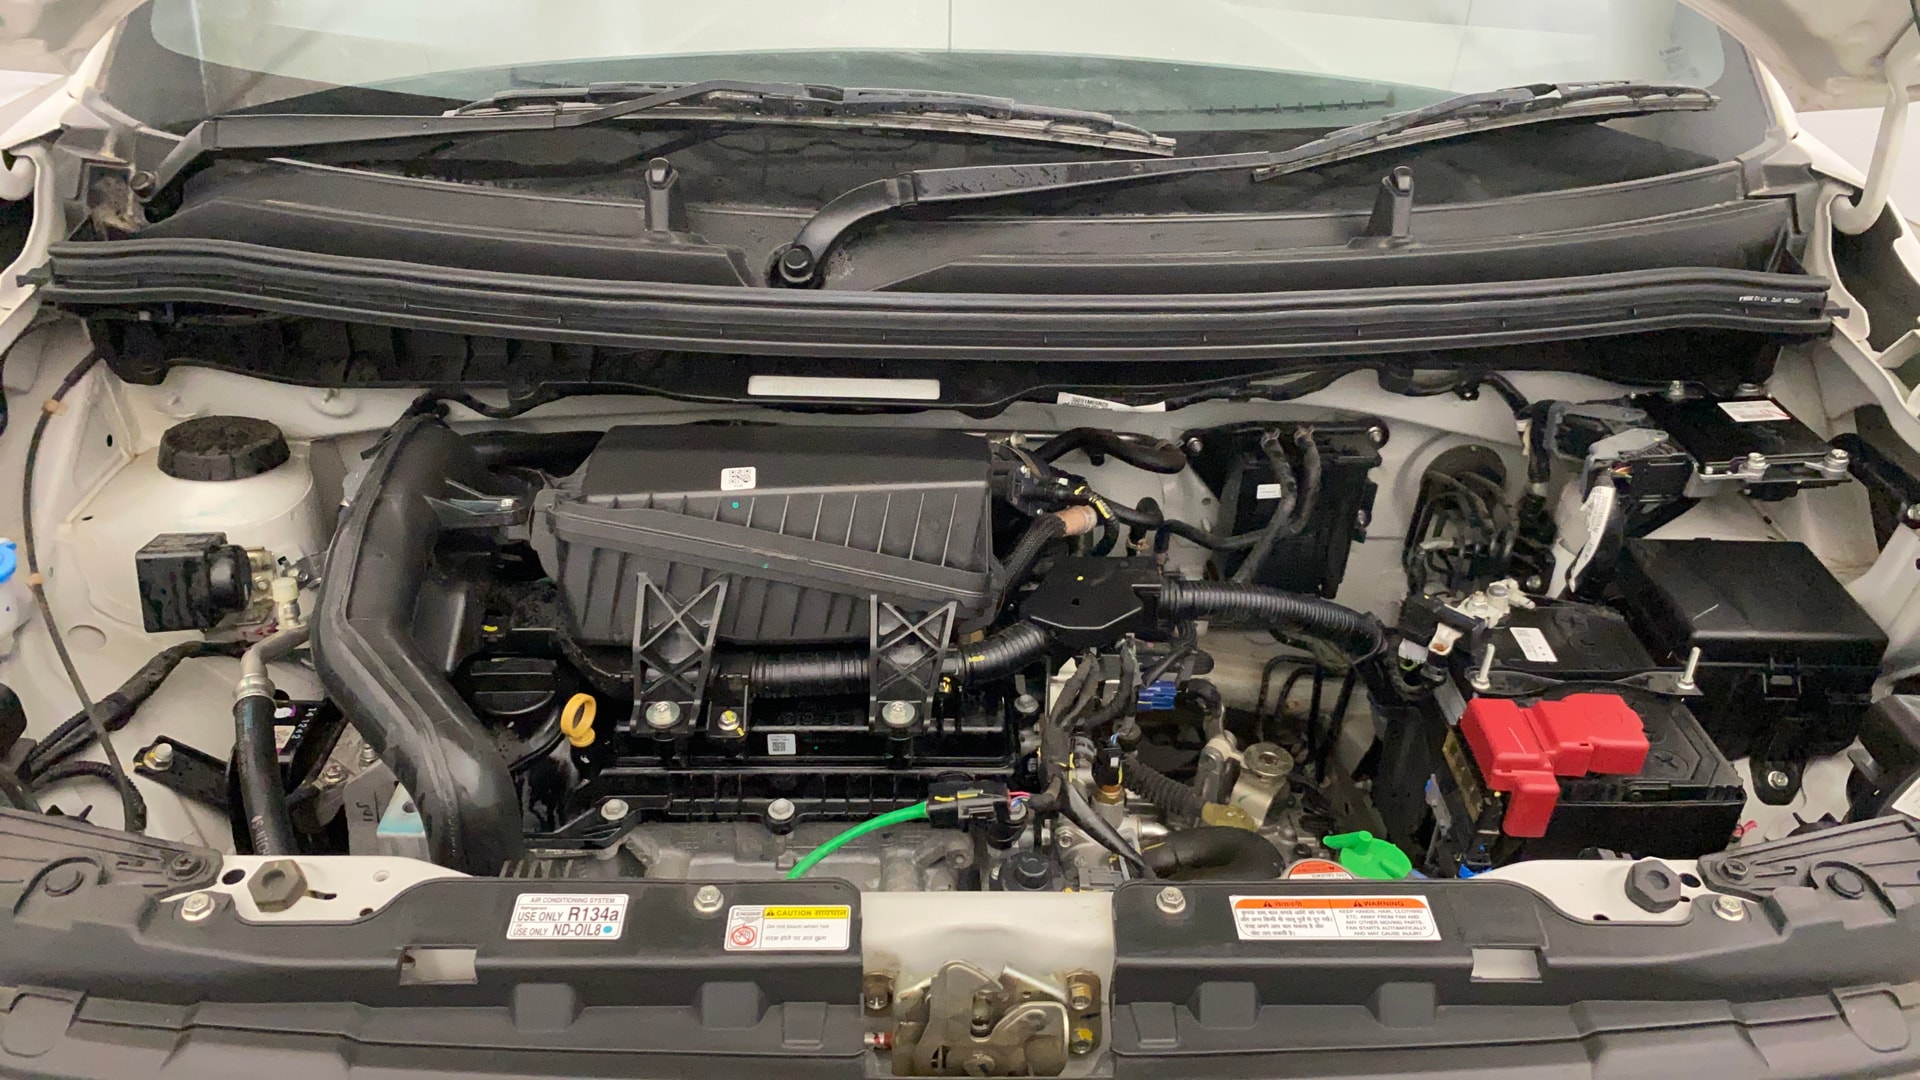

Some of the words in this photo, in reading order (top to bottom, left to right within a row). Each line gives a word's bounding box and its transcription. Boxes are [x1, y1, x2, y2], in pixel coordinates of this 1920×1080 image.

[518, 912, 536, 921] USE
[539, 912, 563, 921] ONLY
[568, 907, 618, 921] R134a
[553, 924, 601, 936] ND-OIL8
